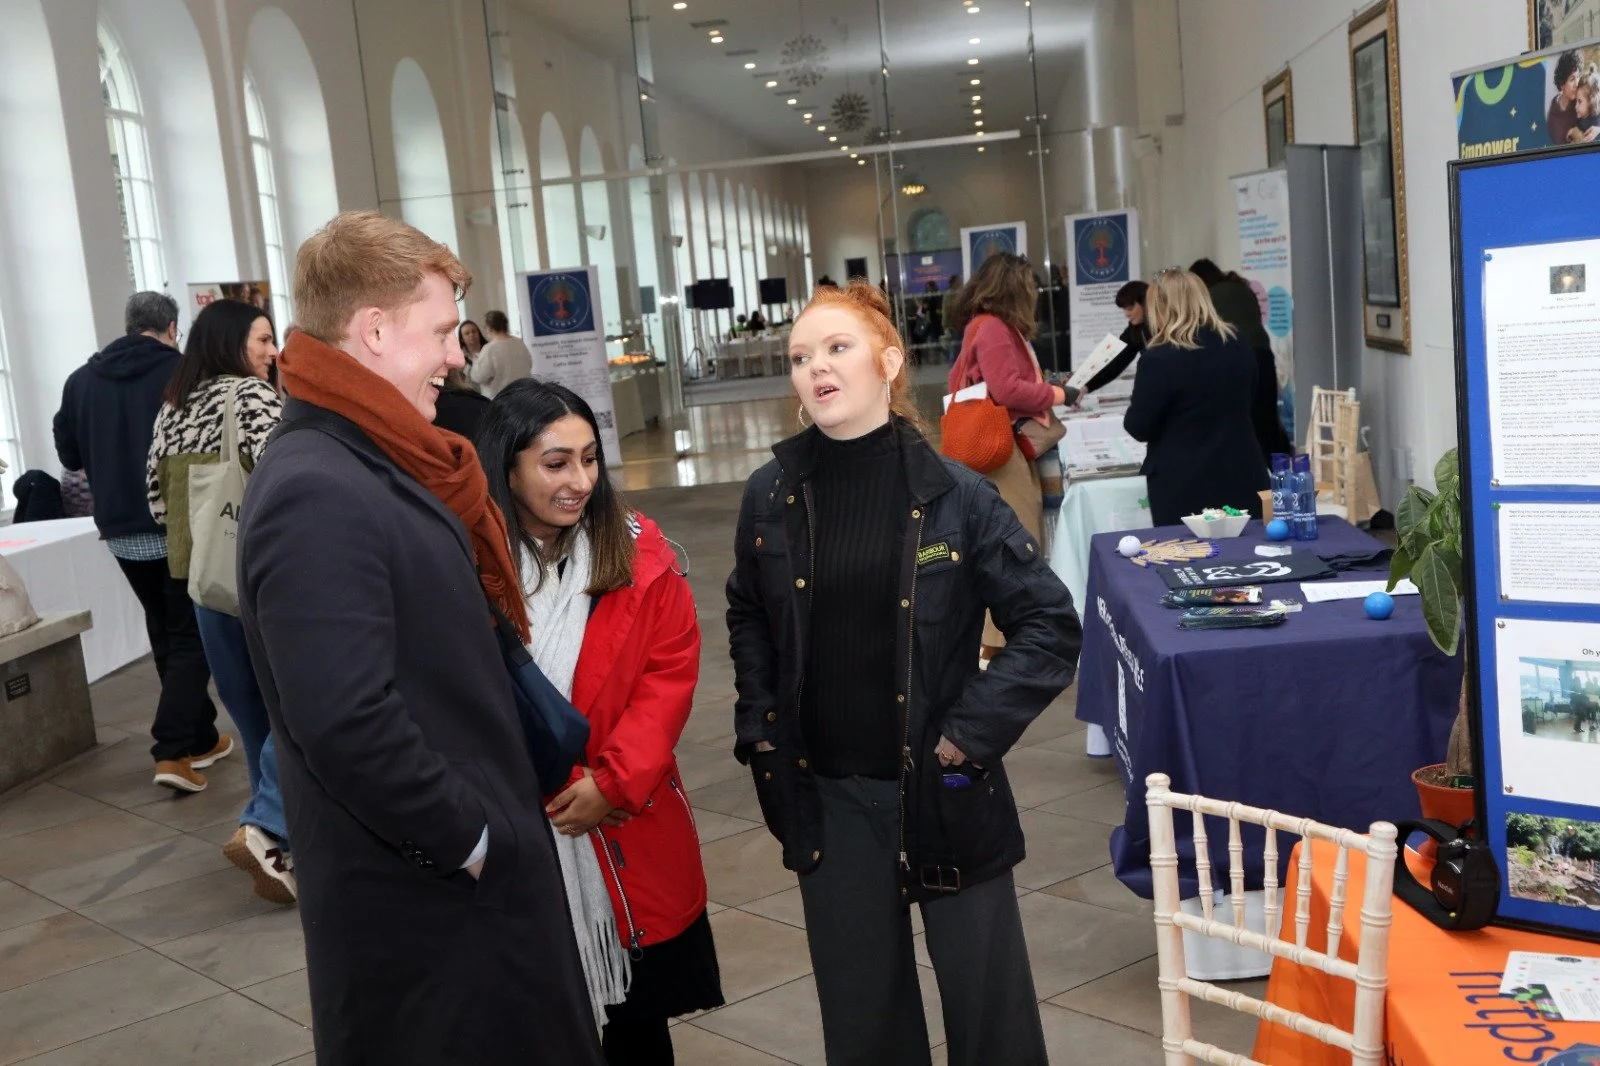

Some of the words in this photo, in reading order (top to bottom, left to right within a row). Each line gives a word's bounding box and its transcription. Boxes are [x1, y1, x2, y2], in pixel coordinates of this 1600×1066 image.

[1461, 136, 1520, 159] Empower
[918, 545, 946, 558] BARBOUR
[1582, 648, 1594, 656] Oh
